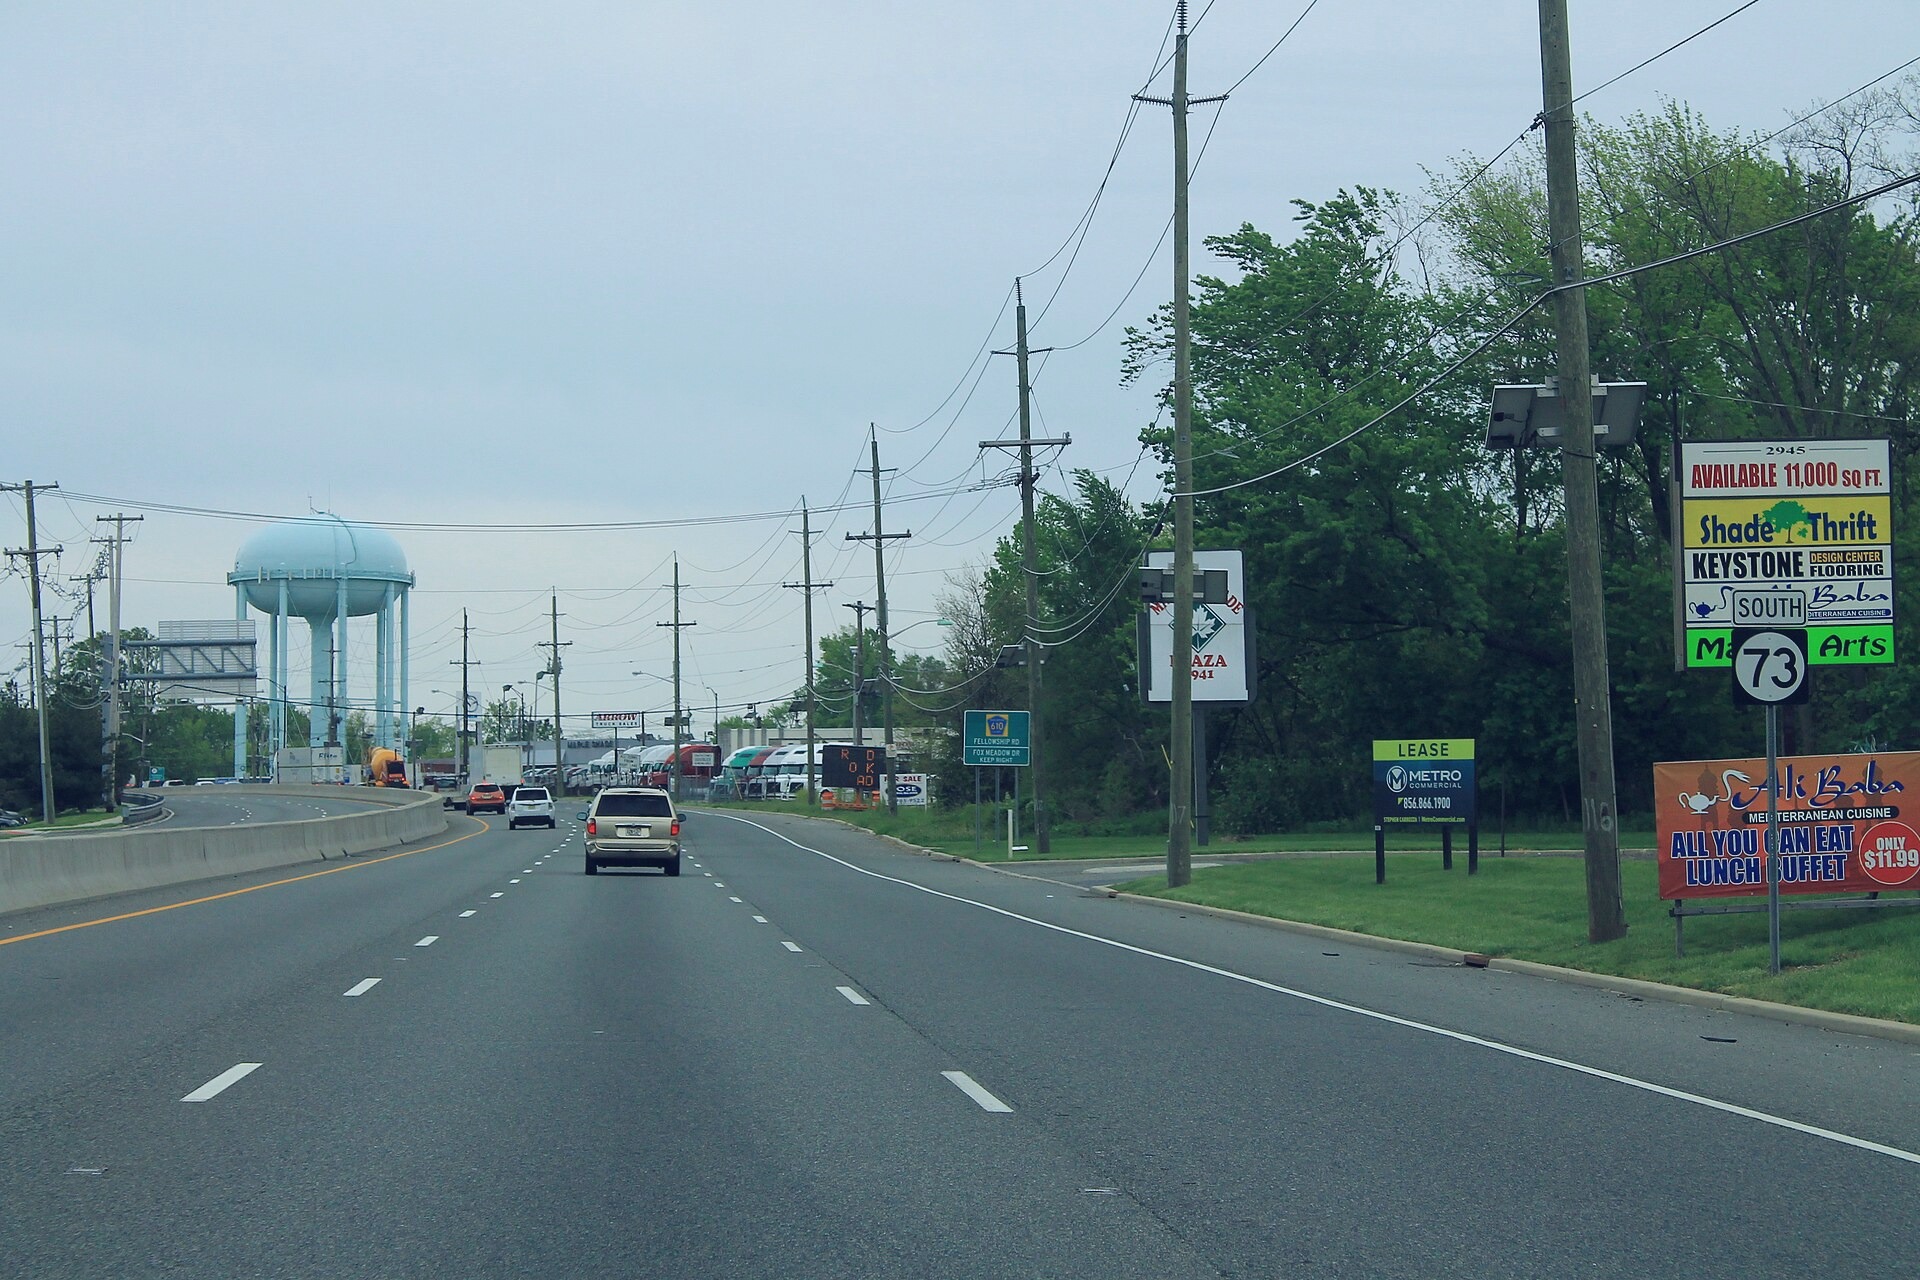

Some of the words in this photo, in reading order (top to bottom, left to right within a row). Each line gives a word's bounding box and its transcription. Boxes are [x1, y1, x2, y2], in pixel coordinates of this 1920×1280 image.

[1766, 446, 1806, 455] 2945
[1691, 463, 1777, 488] AVAILABLE
[1784, 461, 1837, 489] 11,000
[1842, 472, 1860, 488] SQ
[1865, 469, 1883, 486] FT.
[1700, 513, 1775, 544] Shade
[1807, 510, 1877, 541] Thrift
[1692, 551, 1804, 579] KEYSTONE
[1810, 552, 1843, 563] DESIGN
[1846, 551, 1880, 562] CENTER
[1809, 564, 1883, 577] FLOORING
[1807, 581, 1889, 608] Baba
[1738, 597, 1802, 618] SOUTH
[1858, 609, 1886, 617] CUISINE
[1819, 634, 1887, 657] Arts
[1191, 669, 1214, 680] 941
[1743, 647, 1798, 689] 73
[990, 722, 1004, 731] 610
[974, 737, 1010, 745] FELLOWSHIP
[1011, 738, 1020, 746] RD
[1398, 743, 1449, 757] LEASE
[1409, 770, 1461, 781] METRO
[1807, 759, 1905, 808] Baba
[1403, 797, 1451, 809] 856.866.1900
[1749, 810, 1844, 823] METERRANEAN
[1846, 807, 1891, 819] CUISINE
[1671, 831, 1709, 859] ALL
[1713, 828, 1758, 857] YOU
[1815, 825, 1855, 852] EAT
[1876, 837, 1906, 851] ONLY
[1864, 849, 1919, 869] $11.99
[1686, 857, 1761, 886] LUNCH
